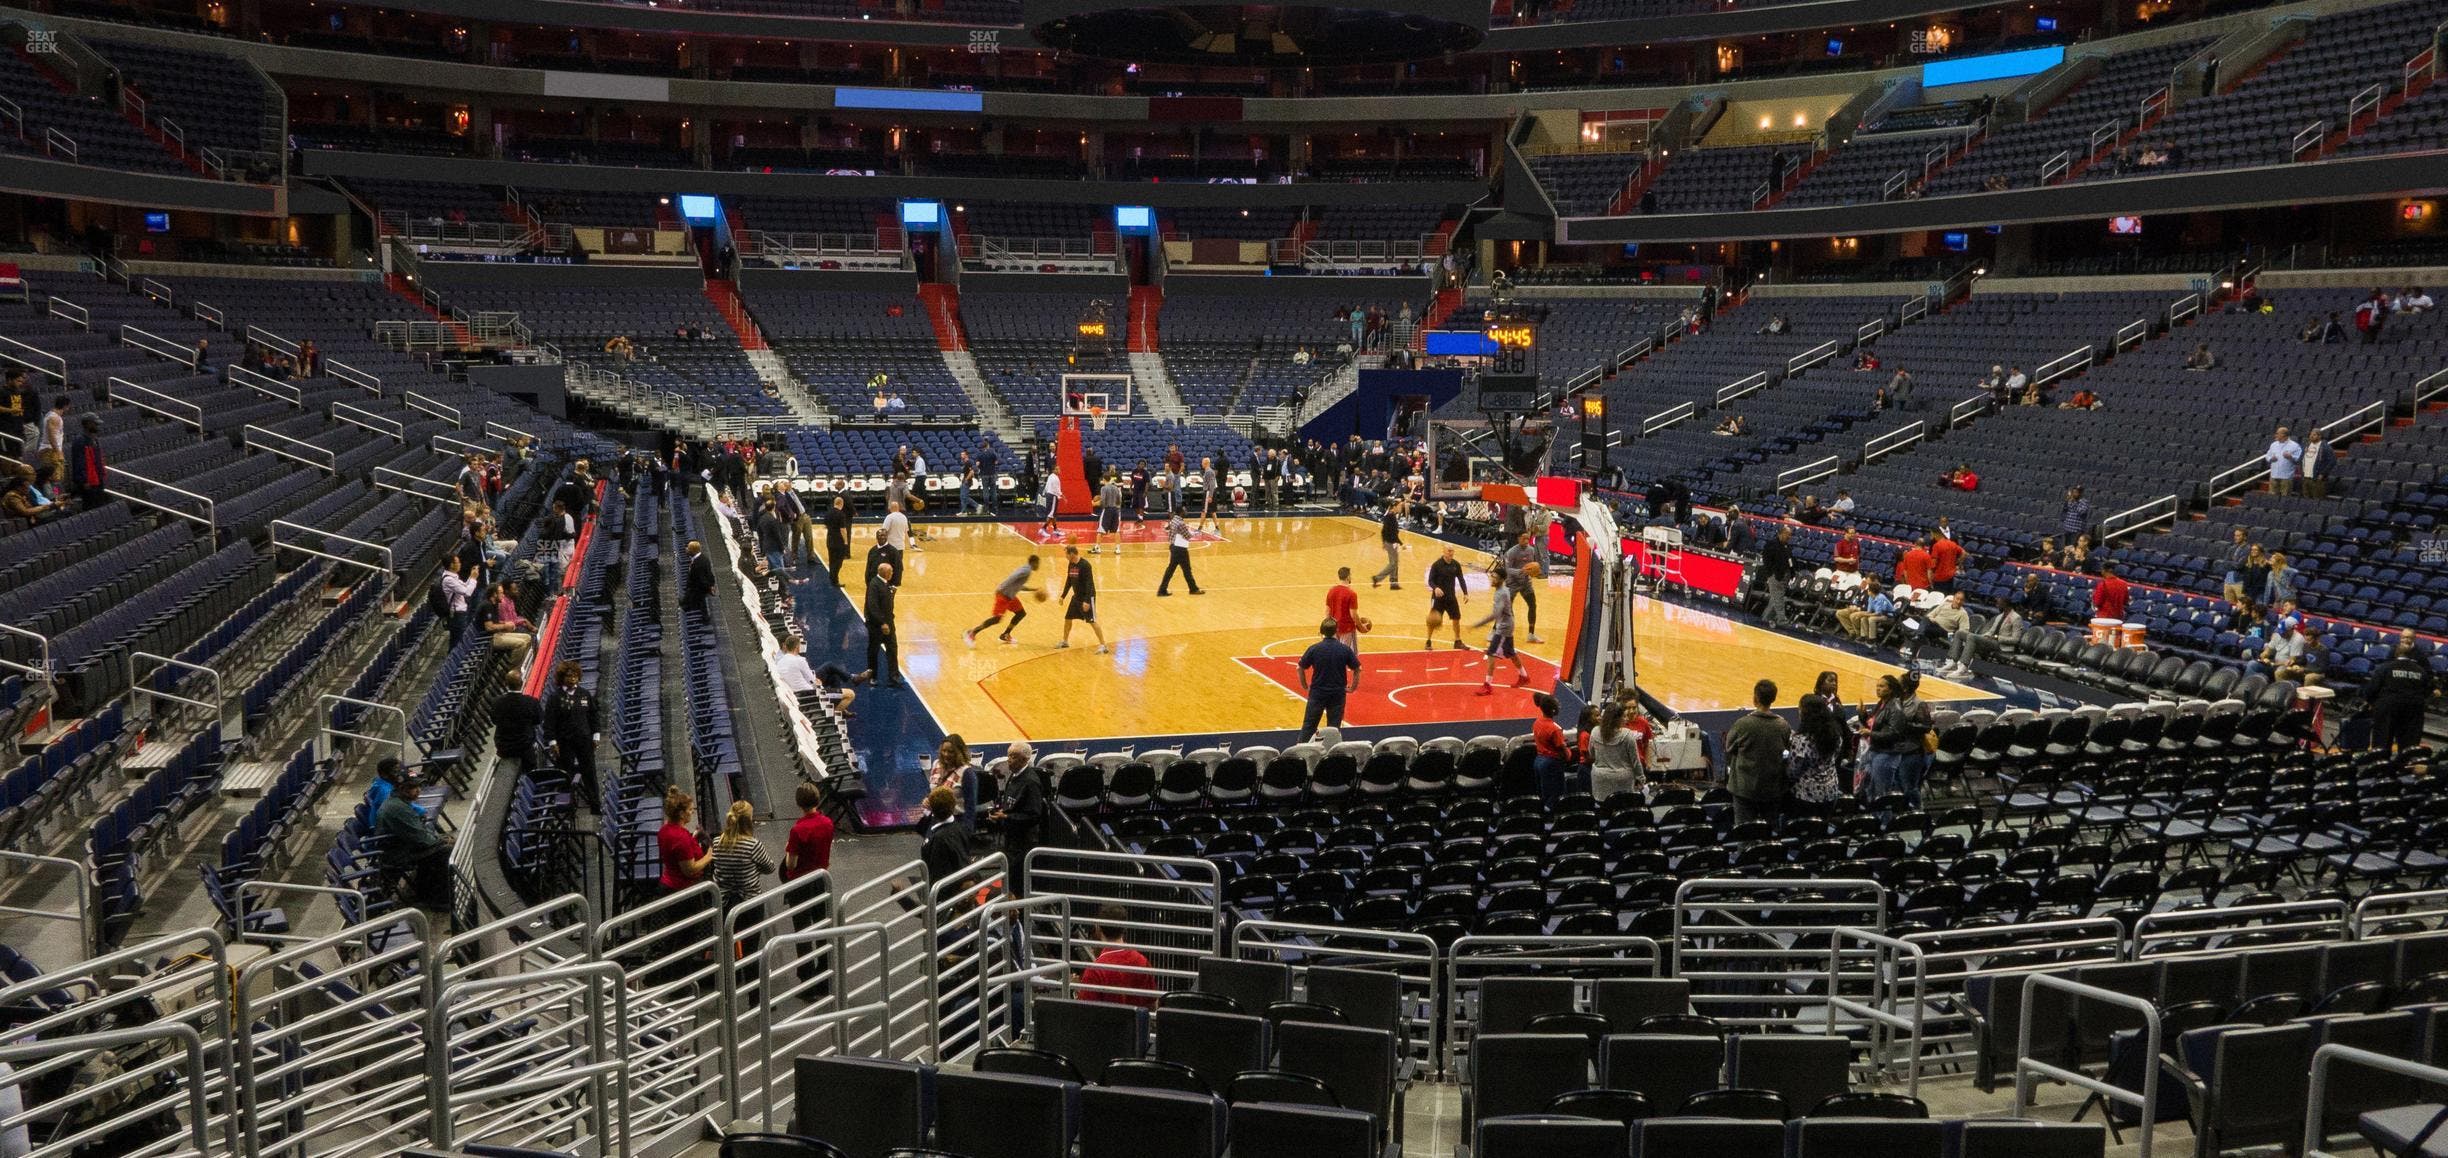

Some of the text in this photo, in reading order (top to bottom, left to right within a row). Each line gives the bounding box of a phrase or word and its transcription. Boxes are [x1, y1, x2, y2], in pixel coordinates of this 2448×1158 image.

[2191, 278, 2207, 292] 101
[1080, 325, 1104, 335] 44:45
[1489, 329, 1531, 346] 44:45
